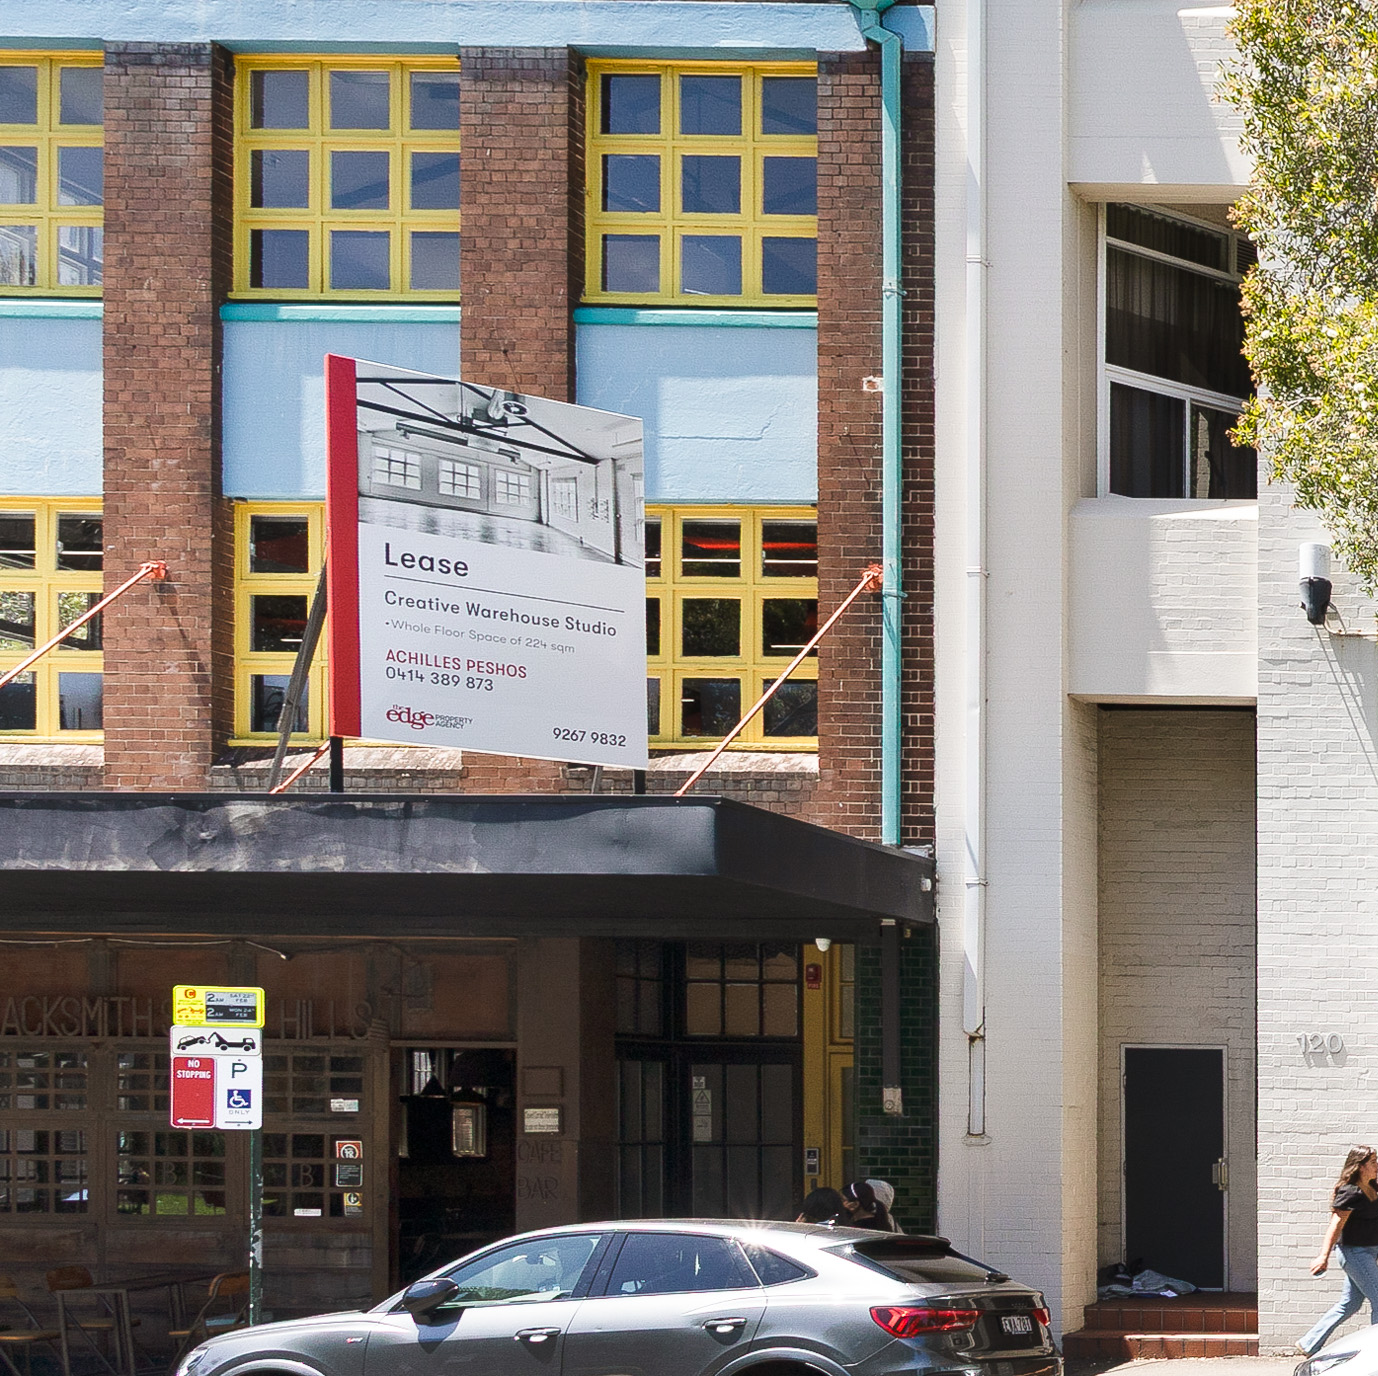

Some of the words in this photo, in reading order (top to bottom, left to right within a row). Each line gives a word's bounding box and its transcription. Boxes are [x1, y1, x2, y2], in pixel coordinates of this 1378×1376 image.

[384, 542, 469, 577] Lease
[384, 590, 460, 614] Creative
[466, 602, 560, 628] Warehouse
[565, 616, 617, 637] Studio
[391, 619, 431, 634] Whole
[434, 625, 465, 638] Floor
[468, 630, 507, 645] Space
[510, 636, 523, 646] of
[525, 638, 548, 649] 224
[550, 643, 575, 654] sqm
[385, 649, 461, 671] ACHILLES
[466, 659, 528, 679] PESHOS
[385, 667, 425, 683] 0414
[430, 672, 461, 687] 389
[466, 677, 494, 691] 873
[386, 707, 435, 730] edge
[435, 714, 473, 725] PROPERTY
[435, 720, 465, 730] AGENCY
[552, 727, 586, 742] 9267
[591, 731, 627, 747] 9832
[1296, 1032, 1345, 1055] 120
[176, 1070, 212, 1079] STOPPING
[187, 1059, 200, 1068] NO
[231, 1062, 248, 1079] P
[518, 1140, 562, 1164] CAFE
[299, 1163, 314, 1187] B
[518, 1176, 558, 1199] BAR
